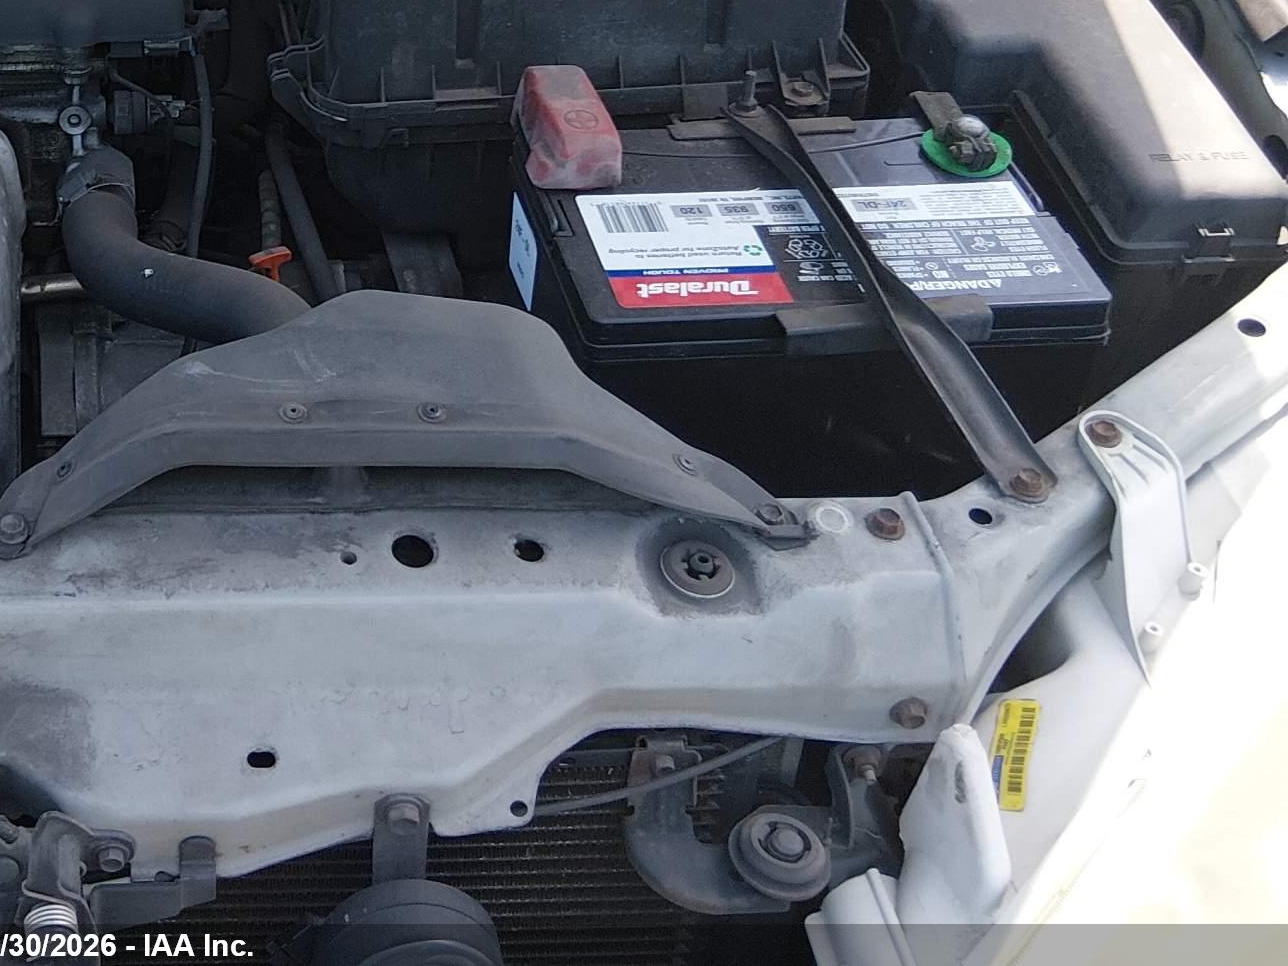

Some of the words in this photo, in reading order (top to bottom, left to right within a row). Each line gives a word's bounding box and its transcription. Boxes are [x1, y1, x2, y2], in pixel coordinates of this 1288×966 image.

[679, 206, 703, 215] 120
[771, 204, 796, 212] 650
[636, 279, 760, 298] Duralast
